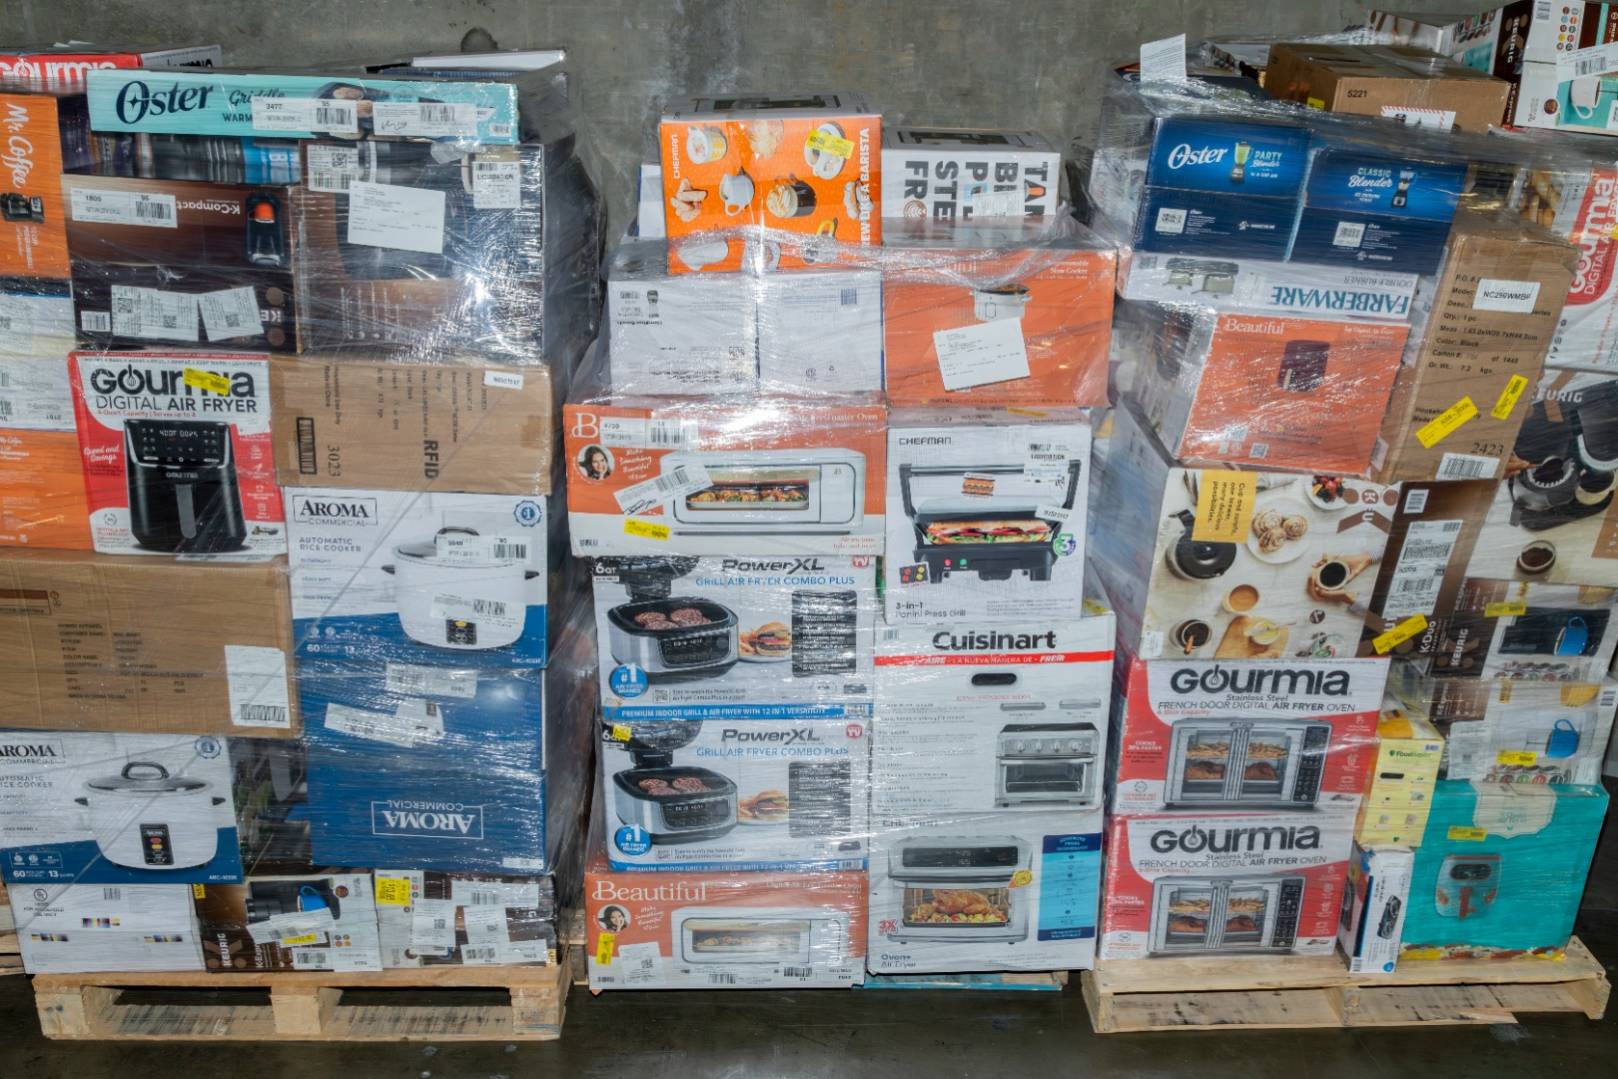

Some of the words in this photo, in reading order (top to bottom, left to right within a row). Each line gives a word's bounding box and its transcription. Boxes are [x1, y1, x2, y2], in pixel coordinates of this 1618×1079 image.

[0, 59, 116, 83] Gourm
[116, 80, 214, 124] Oster
[1347, 89, 1367, 98] 5221
[2, 136, 34, 190] Coffee
[672, 134, 680, 180] CHEFMAN
[861, 128, 870, 182] BARISTA
[1168, 143, 1229, 169] Oster
[1255, 151, 1283, 161] PARTY
[1358, 167, 1392, 178] CLASSIC
[861, 183, 870, 193] A
[1348, 175, 1394, 188] Blender
[861, 194, 870, 221] LIKE
[1584, 248, 1606, 295] DIGITAL
[1272, 286, 1410, 315] FARBERWARE
[1224, 318, 1286, 335] Beautiful
[90, 364, 255, 398] Goura
[95, 394, 161, 411] DIGITAL
[167, 398, 197, 412] AIR
[202, 399, 257, 413] FRYER
[1531, 387, 1584, 403] EURIG
[899, 436, 952, 446] CHEFMAN
[1471, 442, 1505, 456] 2423
[327, 445, 341, 478] 3023
[423, 439, 440, 479] RFID
[1237, 482, 1246, 497] Cup
[300, 499, 369, 518] AROMA
[1234, 498, 1242, 511] and
[299, 535, 353, 546] AUTOMATIC
[722, 557, 825, 575] PowerXL
[695, 576, 725, 586] GRILL
[784, 576, 826, 586] COMBO
[829, 575, 855, 585] PLUS
[932, 630, 1057, 650] Cuisinart
[1419, 621, 1436, 654] K-Duo
[1451, 628, 1469, 667] KEURIG
[1170, 664, 1350, 696] Gourmia
[1226, 693, 1265, 702] Stainless
[1266, 694, 1289, 702] Steel
[621, 708, 655, 716] PREMIUM
[655, 708, 683, 716] INDOOR
[684, 707, 703, 715] GRILL
[721, 707, 742, 715] FRYER
[742, 706, 759, 715] WITH
[1158, 701, 1198, 710] FRENCH
[1199, 701, 1230, 710] DOOR
[1232, 701, 1270, 710] DIGITAL
[1272, 702, 1290, 711] AIR
[1291, 702, 1324, 712] FRYER
[1326, 703, 1355, 712] OVEN
[720, 728, 821, 745] PowerXL
[696, 748, 724, 758] GRILL
[746, 748, 779, 758] FRYER
[780, 748, 823, 758] COMBO
[387, 799, 464, 811] COMMERCIAL
[381, 810, 476, 835] AROMA
[1150, 824, 1321, 854] Gourmia
[1139, 859, 1178, 868] FRENCH
[1179, 859, 1209, 868] DOOR
[1211, 859, 1248, 868] DIGITAL
[1249, 858, 1266, 866] AIR
[1267, 856, 1299, 866] FRYER
[1300, 855, 1328, 865] OVEN
[1206, 853, 1242, 861] Stainless
[1243, 851, 1265, 859] Steel
[13, 869, 26, 878] 60
[48, 869, 59, 878] 13
[591, 880, 707, 901] Beautiful
[221, 932, 230, 968] KEURIG
